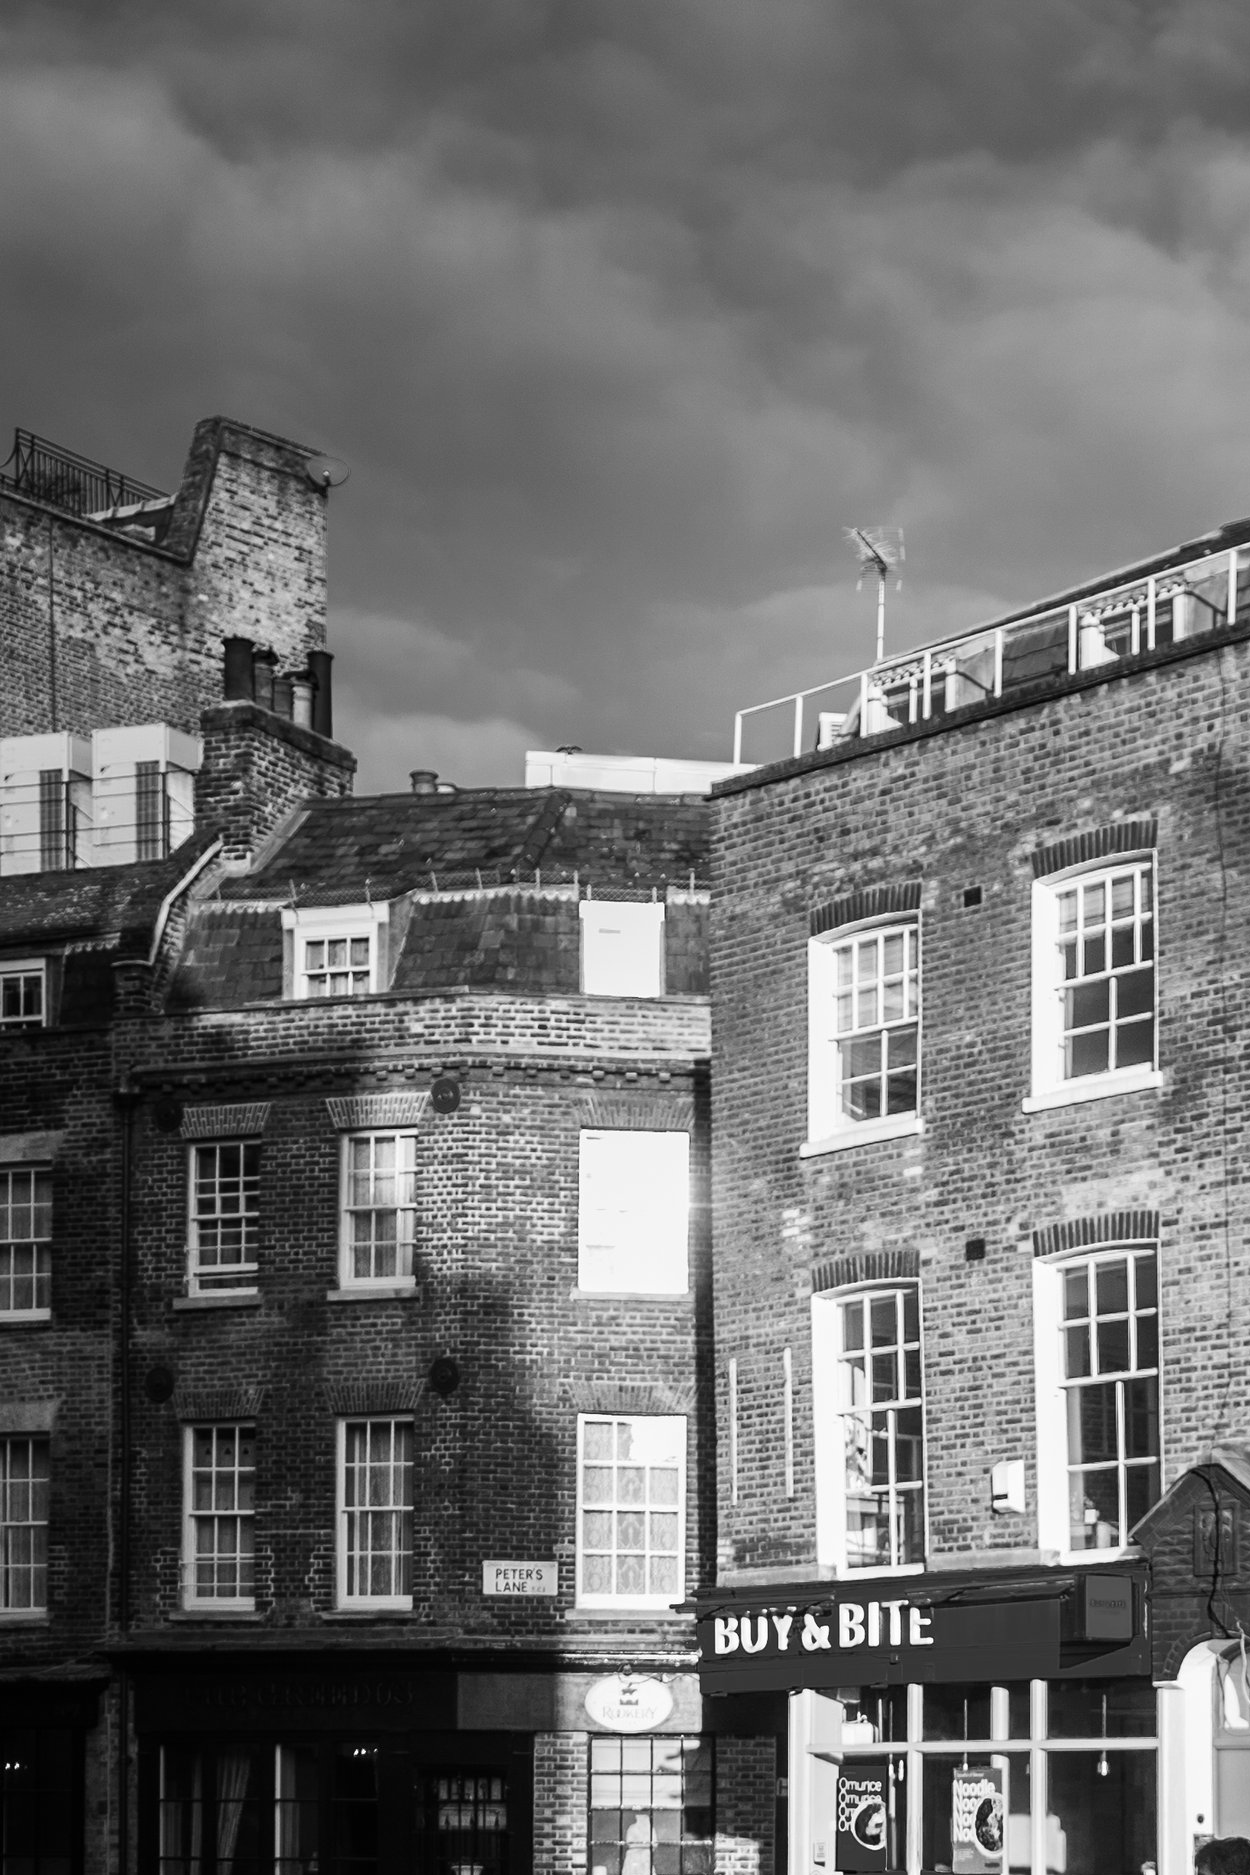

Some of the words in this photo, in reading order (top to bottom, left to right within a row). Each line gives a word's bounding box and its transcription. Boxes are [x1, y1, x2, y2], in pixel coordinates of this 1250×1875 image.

[495, 1568, 543, 1580] PETER'S
[495, 1581, 528, 1592] LANE
[714, 1607, 796, 1655] BUY
[801, 1606, 832, 1652] &
[839, 1600, 934, 1648] BITE
[953, 1779, 995, 1797] Noodle
